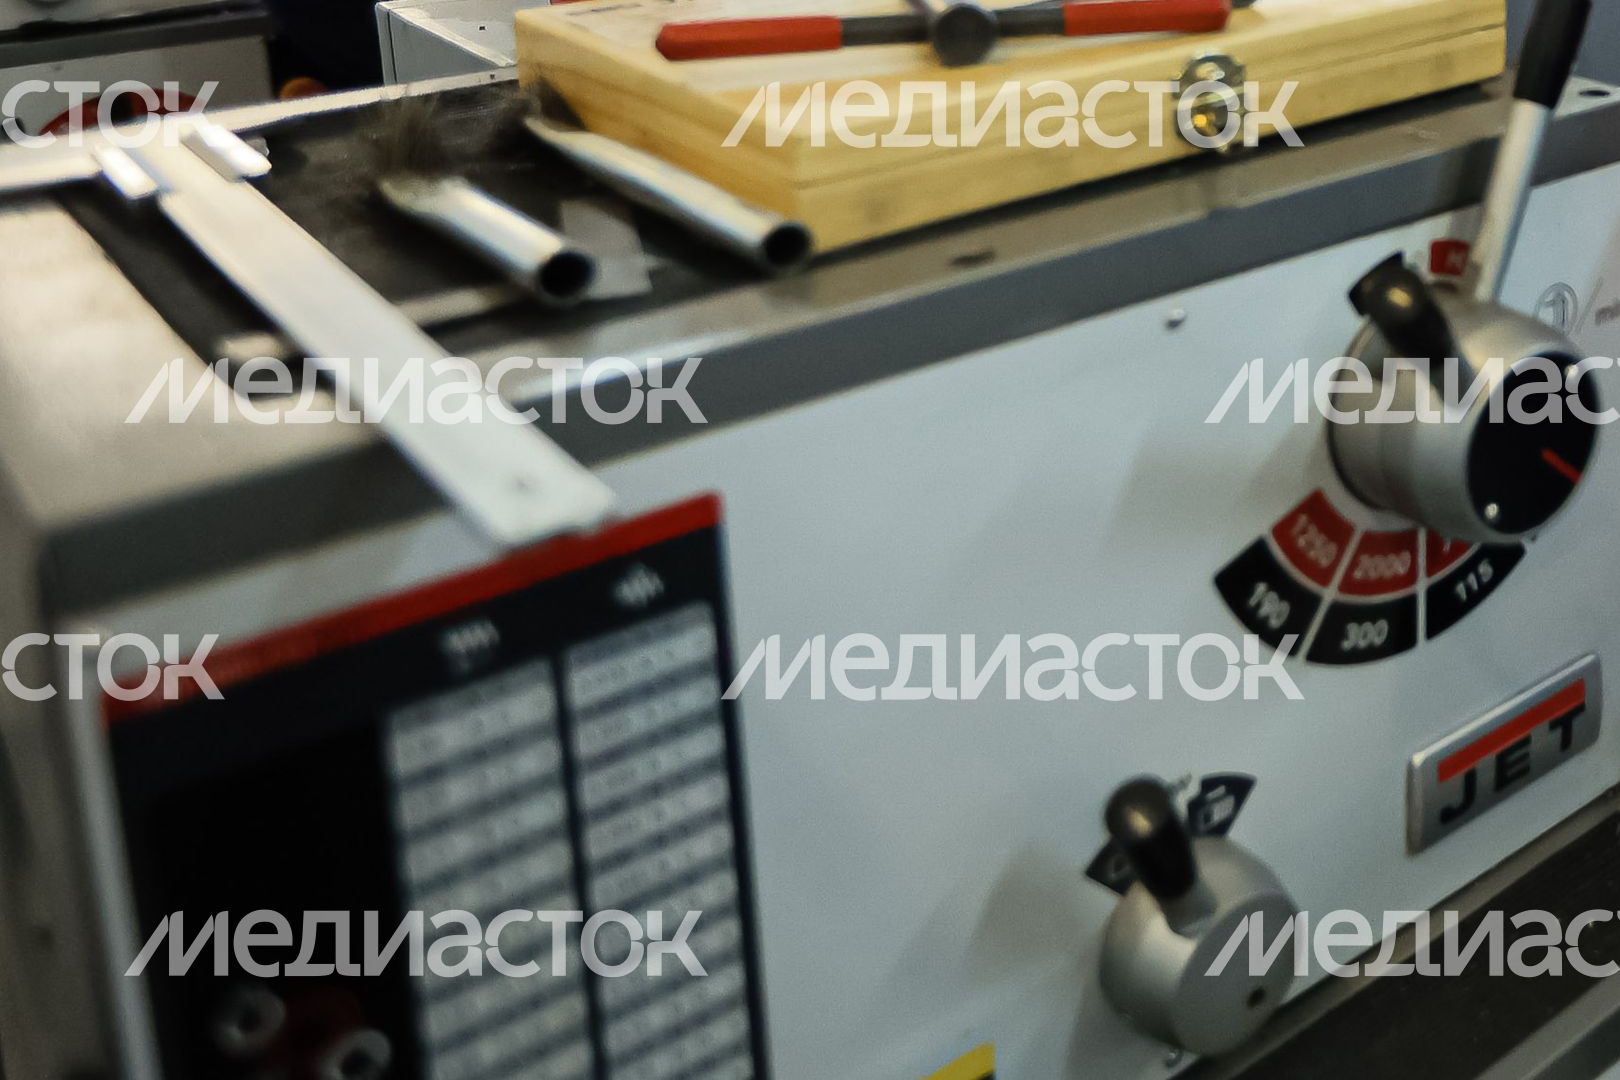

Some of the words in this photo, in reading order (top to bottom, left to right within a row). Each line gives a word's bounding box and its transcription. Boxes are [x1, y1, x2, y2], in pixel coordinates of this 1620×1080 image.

[1353, 550, 1411, 580] 2000
[1341, 619, 1389, 651] 300
[1440, 702, 1586, 825] JET
